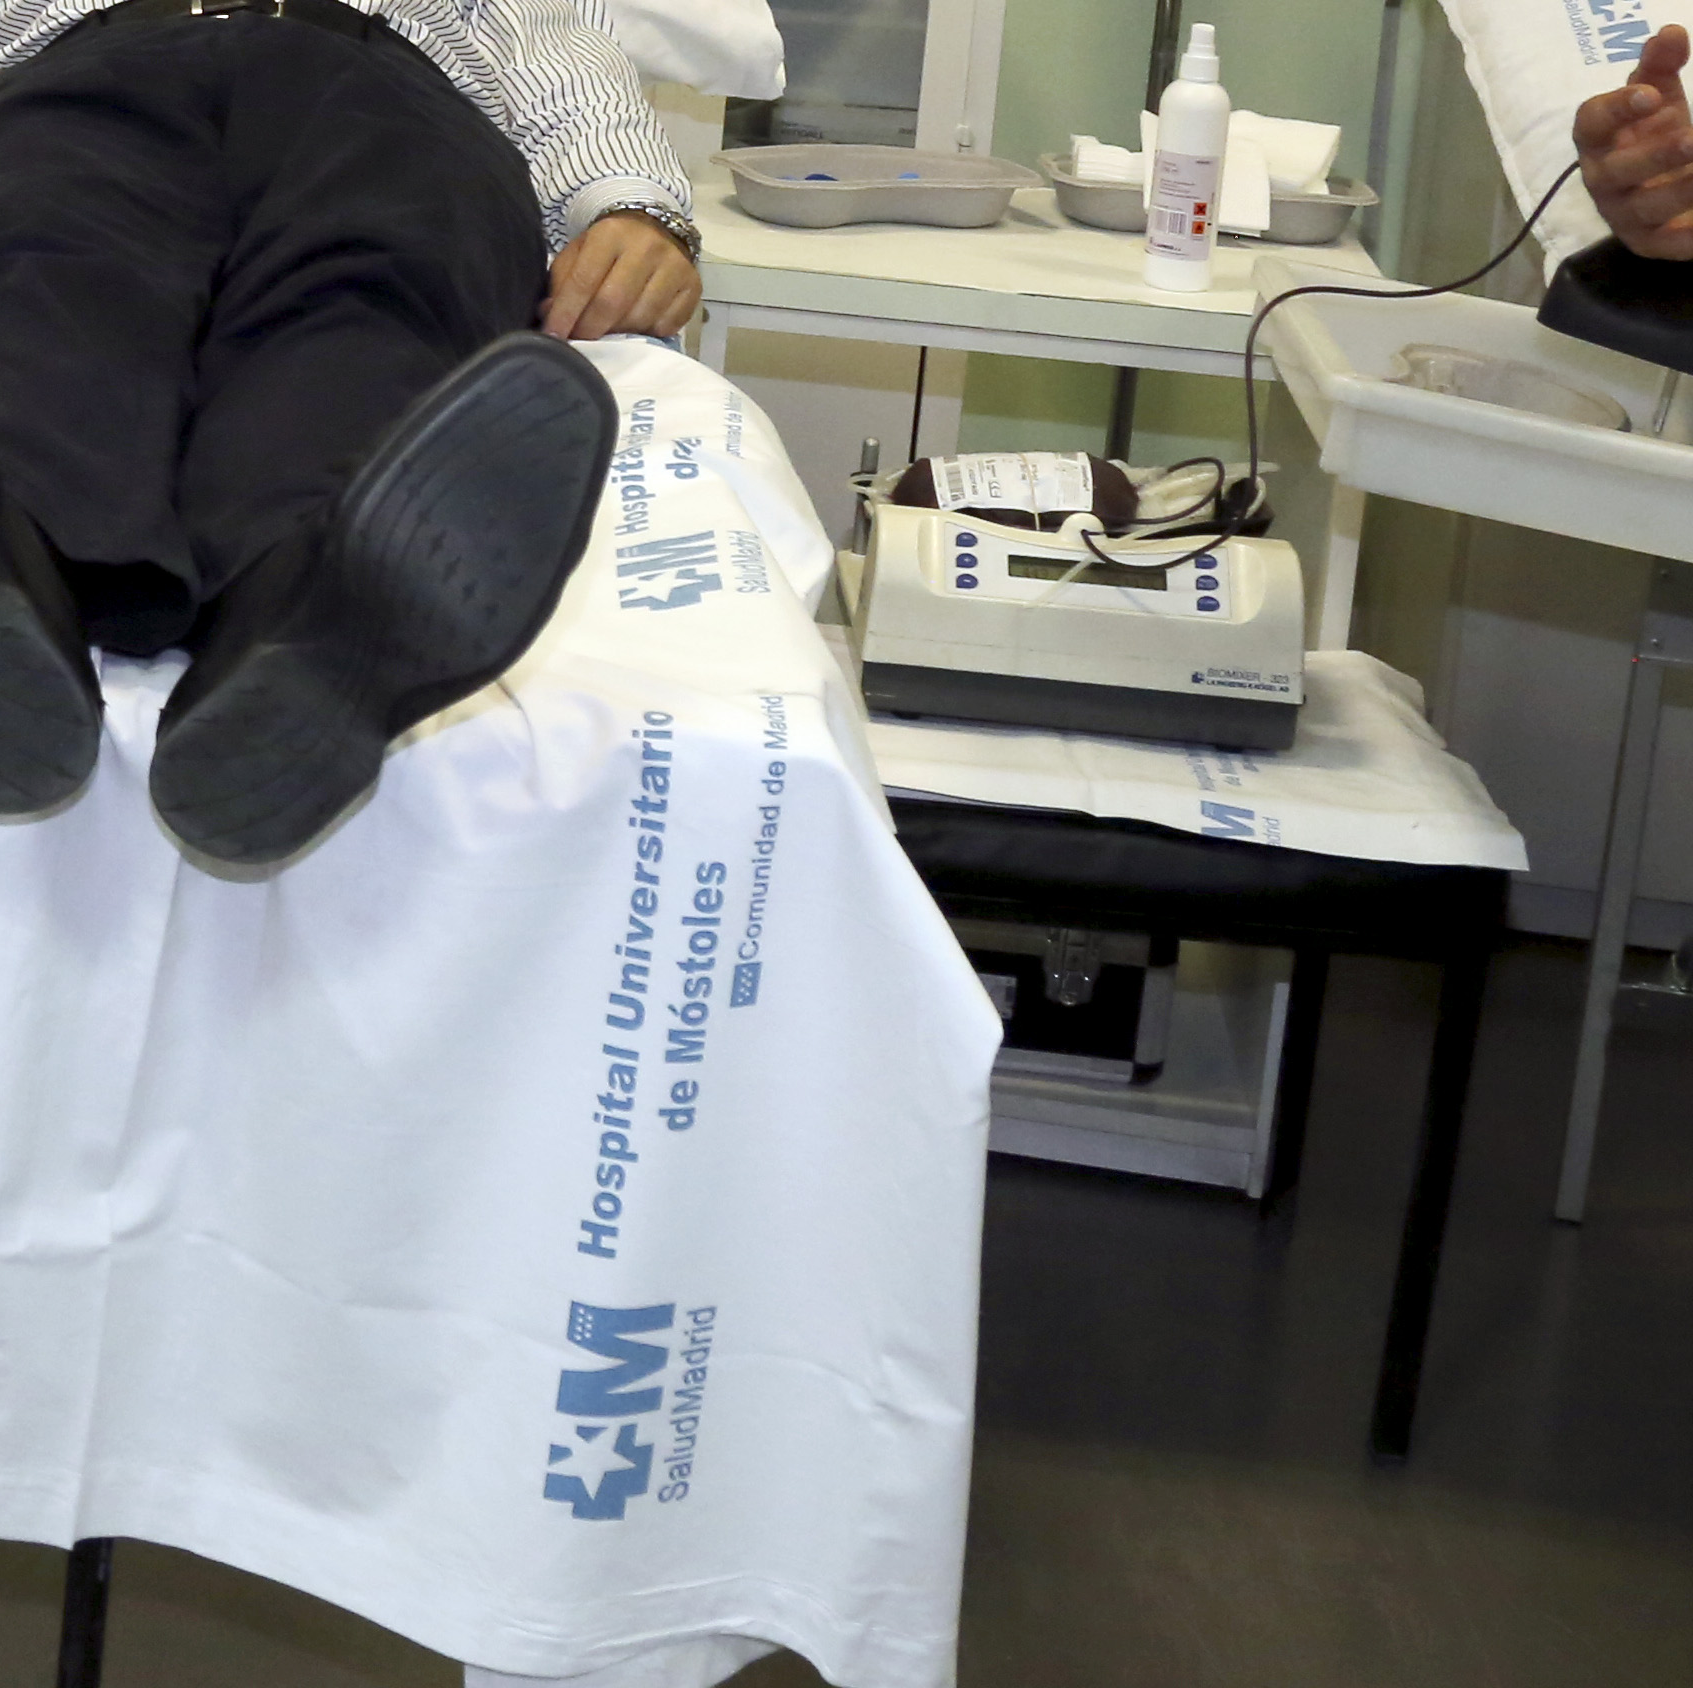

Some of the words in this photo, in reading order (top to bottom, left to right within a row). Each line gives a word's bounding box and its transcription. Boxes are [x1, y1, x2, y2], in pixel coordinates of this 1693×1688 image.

[727, 530, 771, 594] SaludMadrid
[763, 692, 785, 751] Madrid
[765, 760, 787, 796] de
[606, 709, 675, 1032] Universitario
[737, 804, 781, 960] Comunidad
[664, 859, 728, 1065] Móstoles
[576, 1043, 640, 1260] Hospital
[658, 1078, 701, 1132] de
[657, 1304, 718, 1504] SaludMadrid
